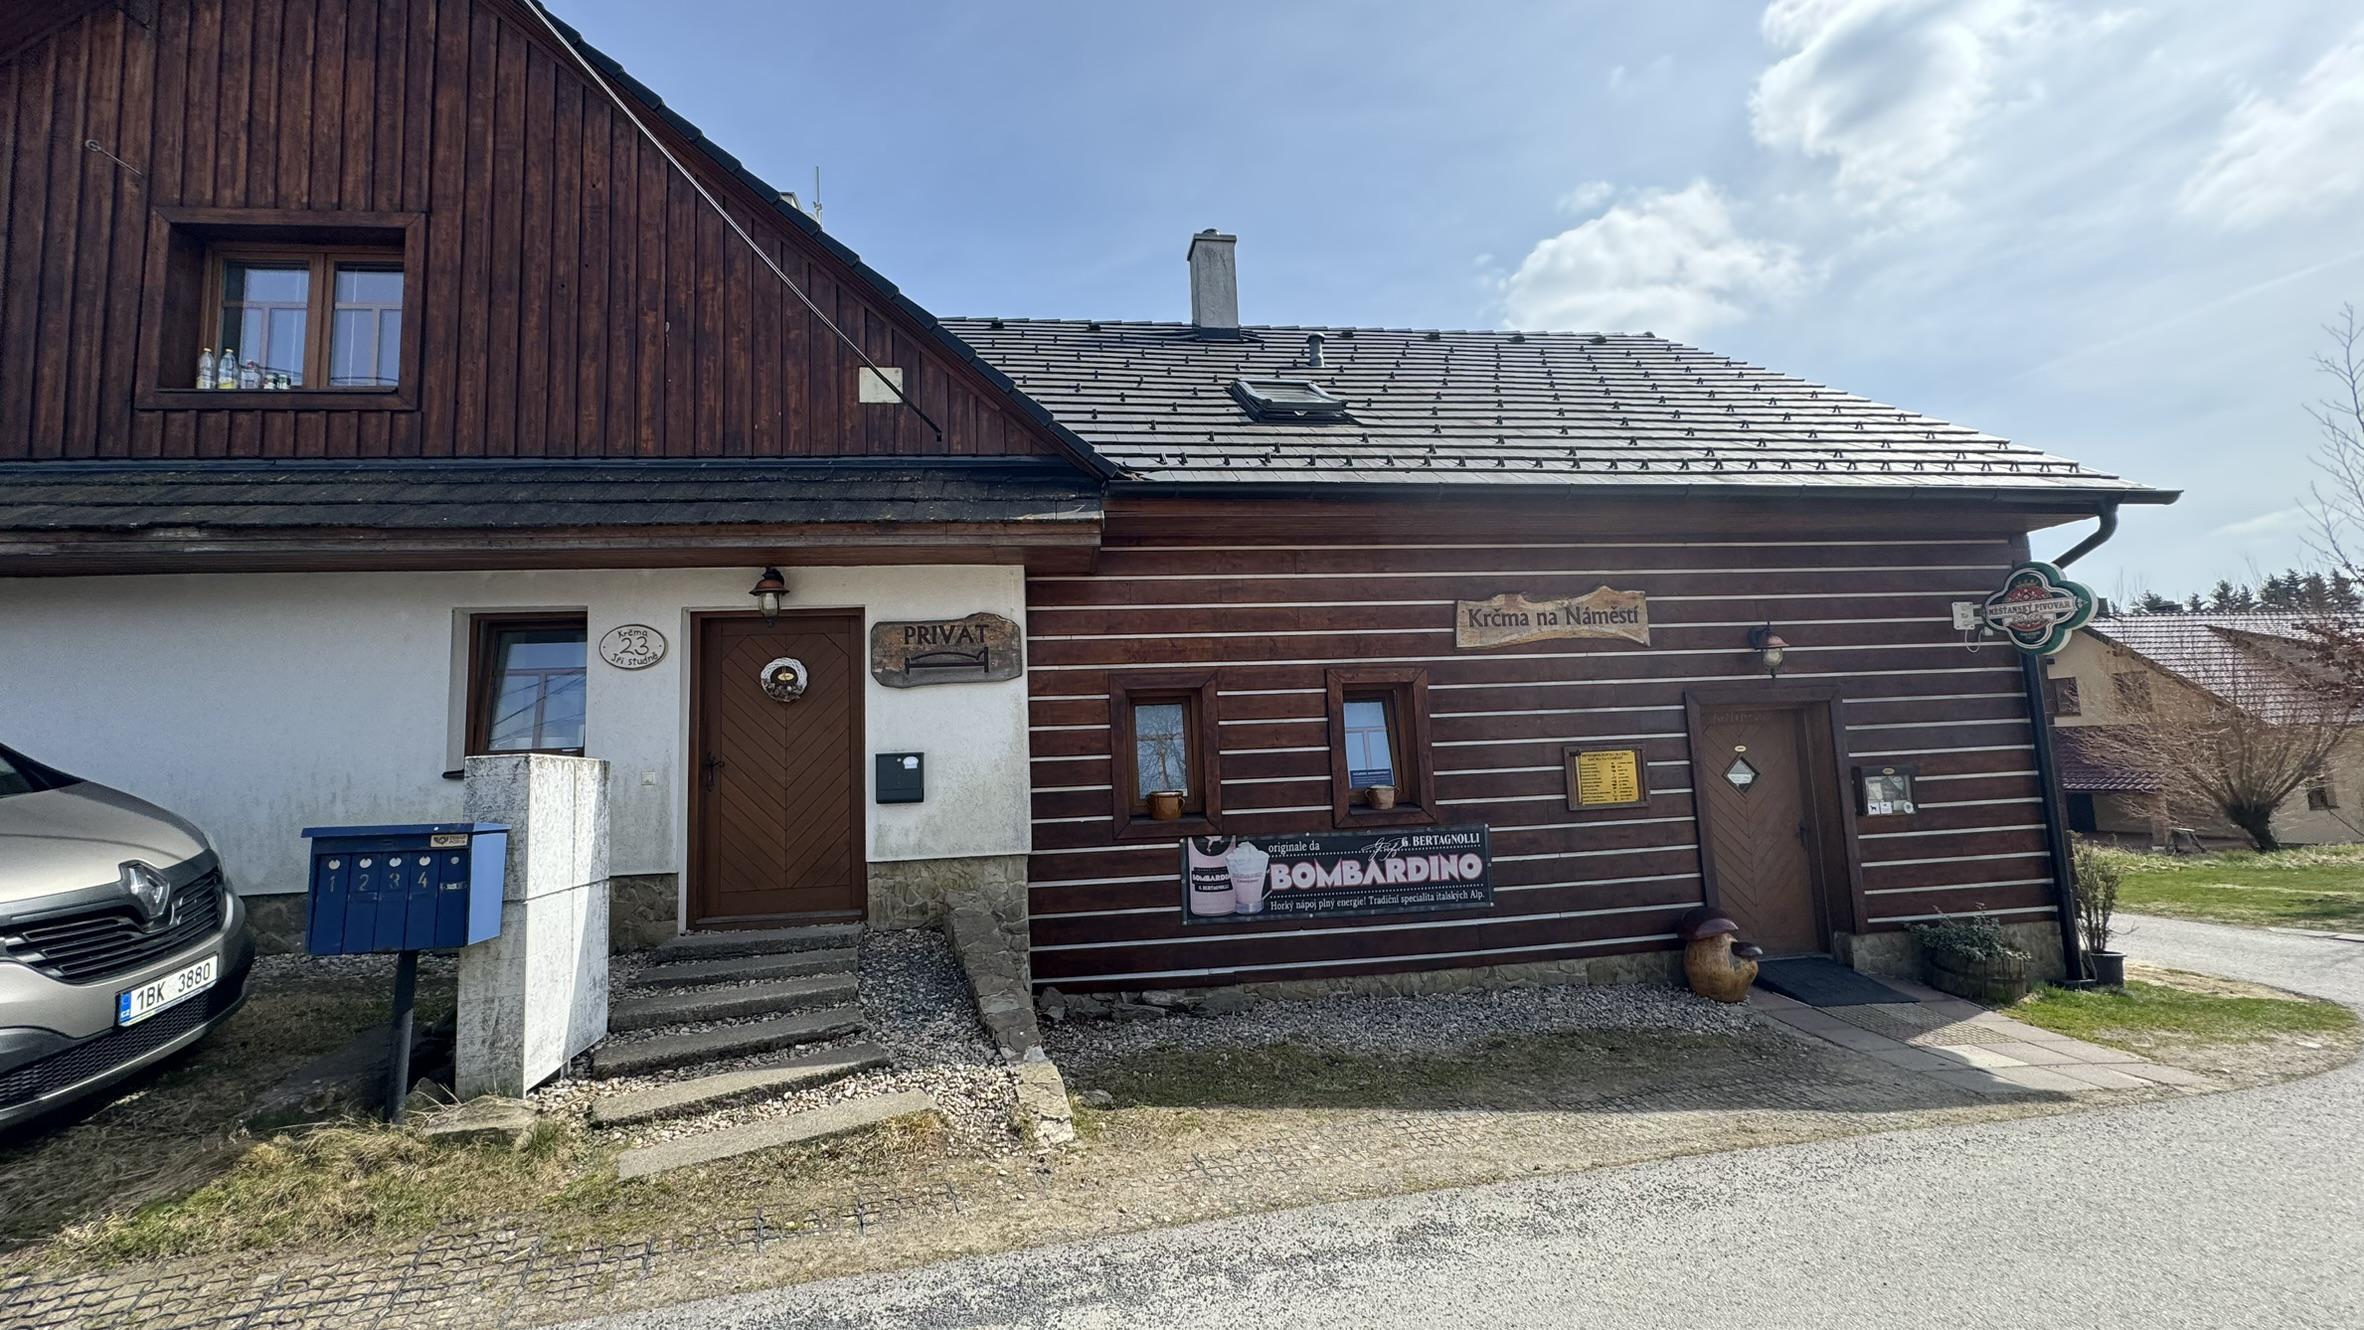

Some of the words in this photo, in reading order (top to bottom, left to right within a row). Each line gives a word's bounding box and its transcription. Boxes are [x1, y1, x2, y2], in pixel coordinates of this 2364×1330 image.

[1468, 608, 1530, 628] Krčma
[1537, 611, 1558, 626] na
[1565, 605, 1639, 626] Náměstí
[2035, 600, 2071, 613] PIVOVAR
[903, 624, 990, 645] PRIVAT
[619, 636, 650, 656] 23
[628, 652, 658, 665] studně
[1268, 841, 1307, 855] originale
[1309, 840, 1320, 851] da
[1412, 833, 1480, 846] BERTAGNOLLI
[359, 874, 370, 891] 2
[388, 872, 400, 889] 3
[417, 871, 428, 889] 4
[1270, 853, 1482, 889] BOMBARDINO
[1270, 899, 1294, 912] Horký
[1296, 898, 1317, 911] nápoj
[1318, 898, 1335, 910] plný
[1336, 897, 1367, 909] energie!
[1368, 893, 1399, 906] Tradiční
[1401, 892, 1435, 906] specialita
[1436, 890, 1468, 902] italských
[1470, 889, 1485, 900] Alp.
[136, 980, 167, 1011] 1BK
[178, 962, 211, 993] 3880
